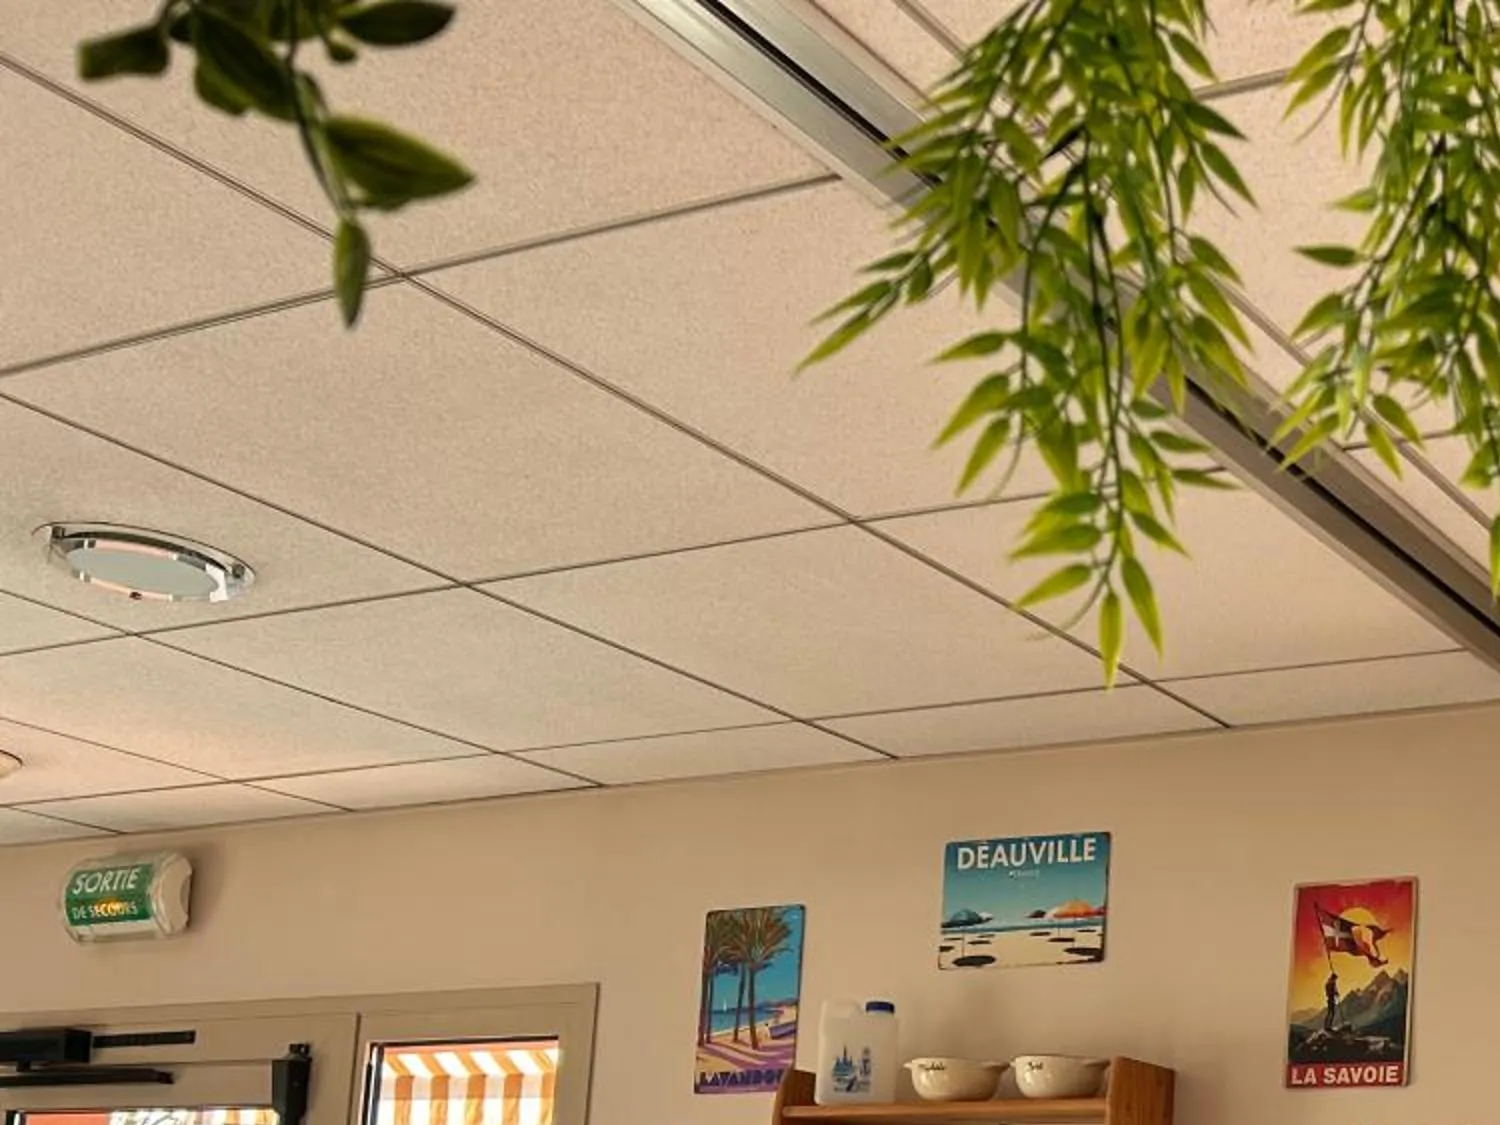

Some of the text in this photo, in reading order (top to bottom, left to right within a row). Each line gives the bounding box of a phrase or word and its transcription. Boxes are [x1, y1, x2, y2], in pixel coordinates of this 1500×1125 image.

[957, 838, 1096, 869] DEAUVILLE
[72, 867, 141, 895] SORTIE
[1291, 1065, 1399, 1085] LA SAVOIE
